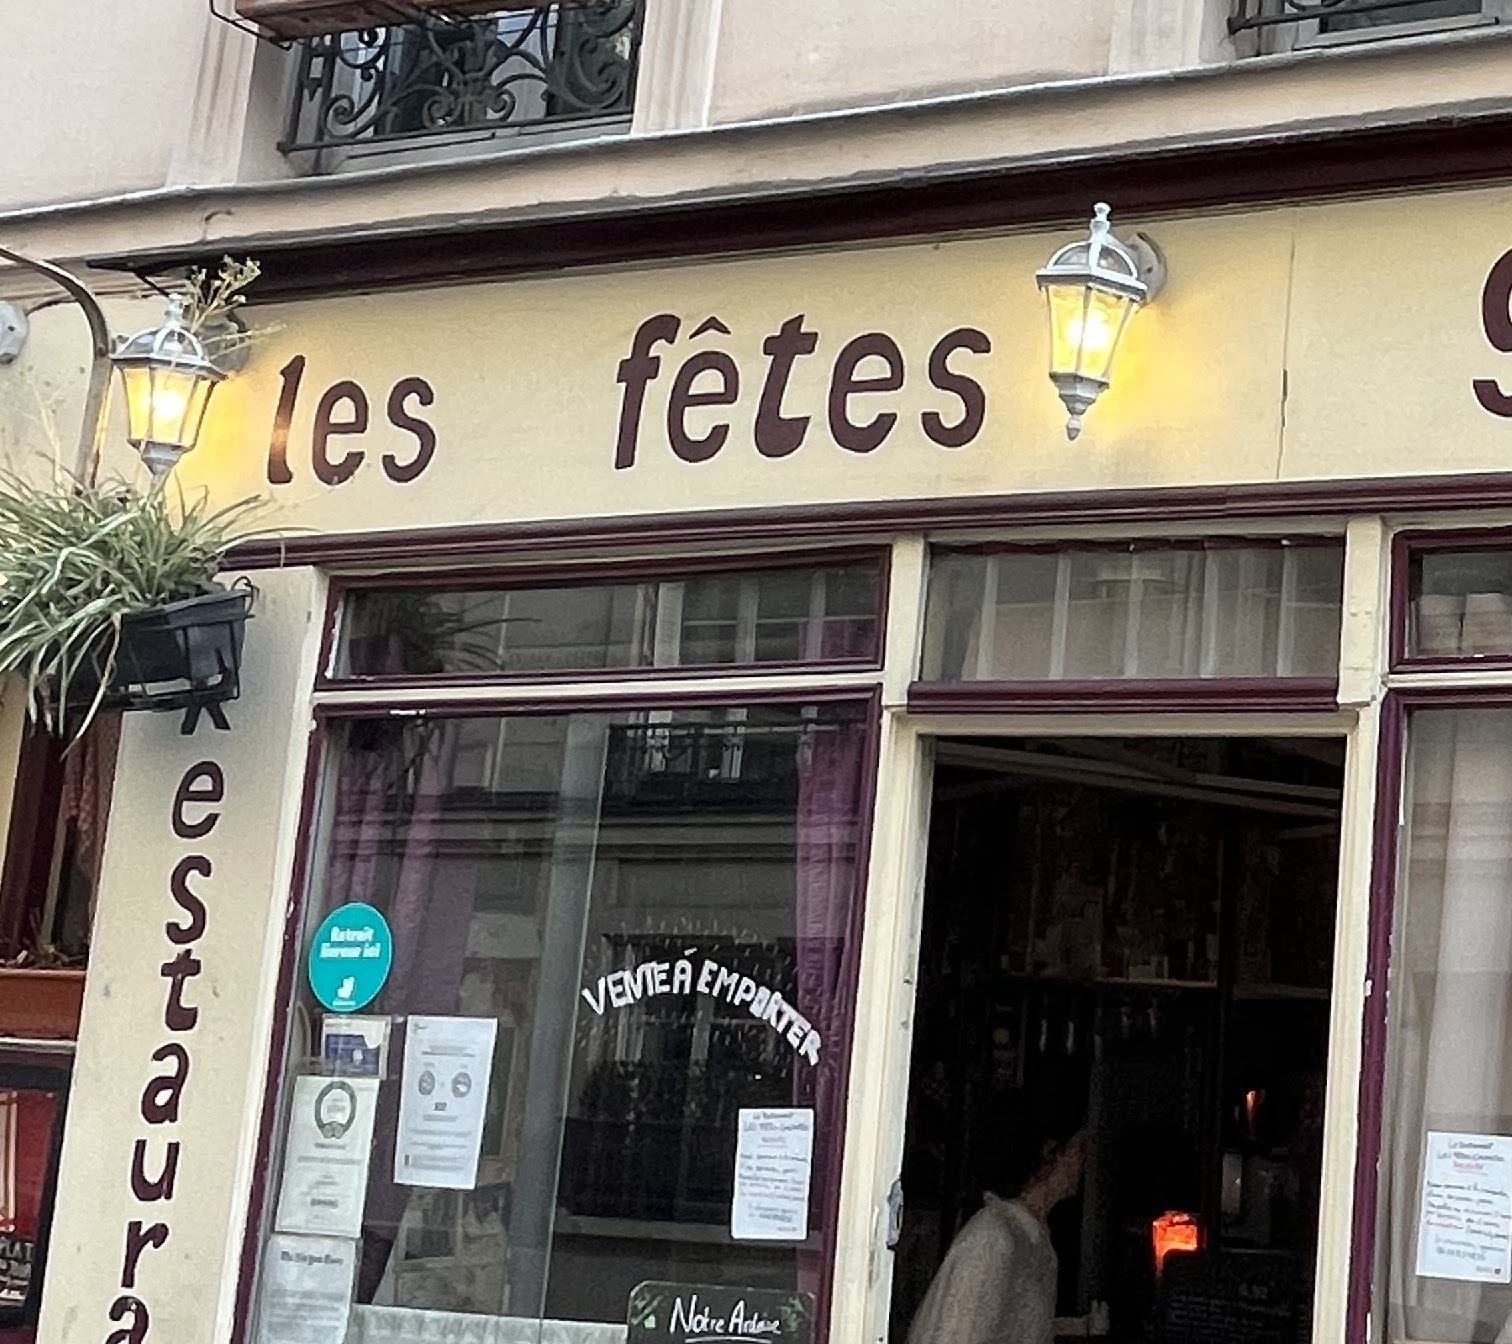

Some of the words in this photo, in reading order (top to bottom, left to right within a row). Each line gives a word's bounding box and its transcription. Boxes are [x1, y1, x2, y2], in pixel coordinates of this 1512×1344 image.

[266, 354, 437, 485] les
[613, 313, 991, 470] fêtes
[581, 960, 671, 1015] VENTE
[696, 958, 822, 1067] EMPORTER
[669, 1294, 725, 1335] Notre
